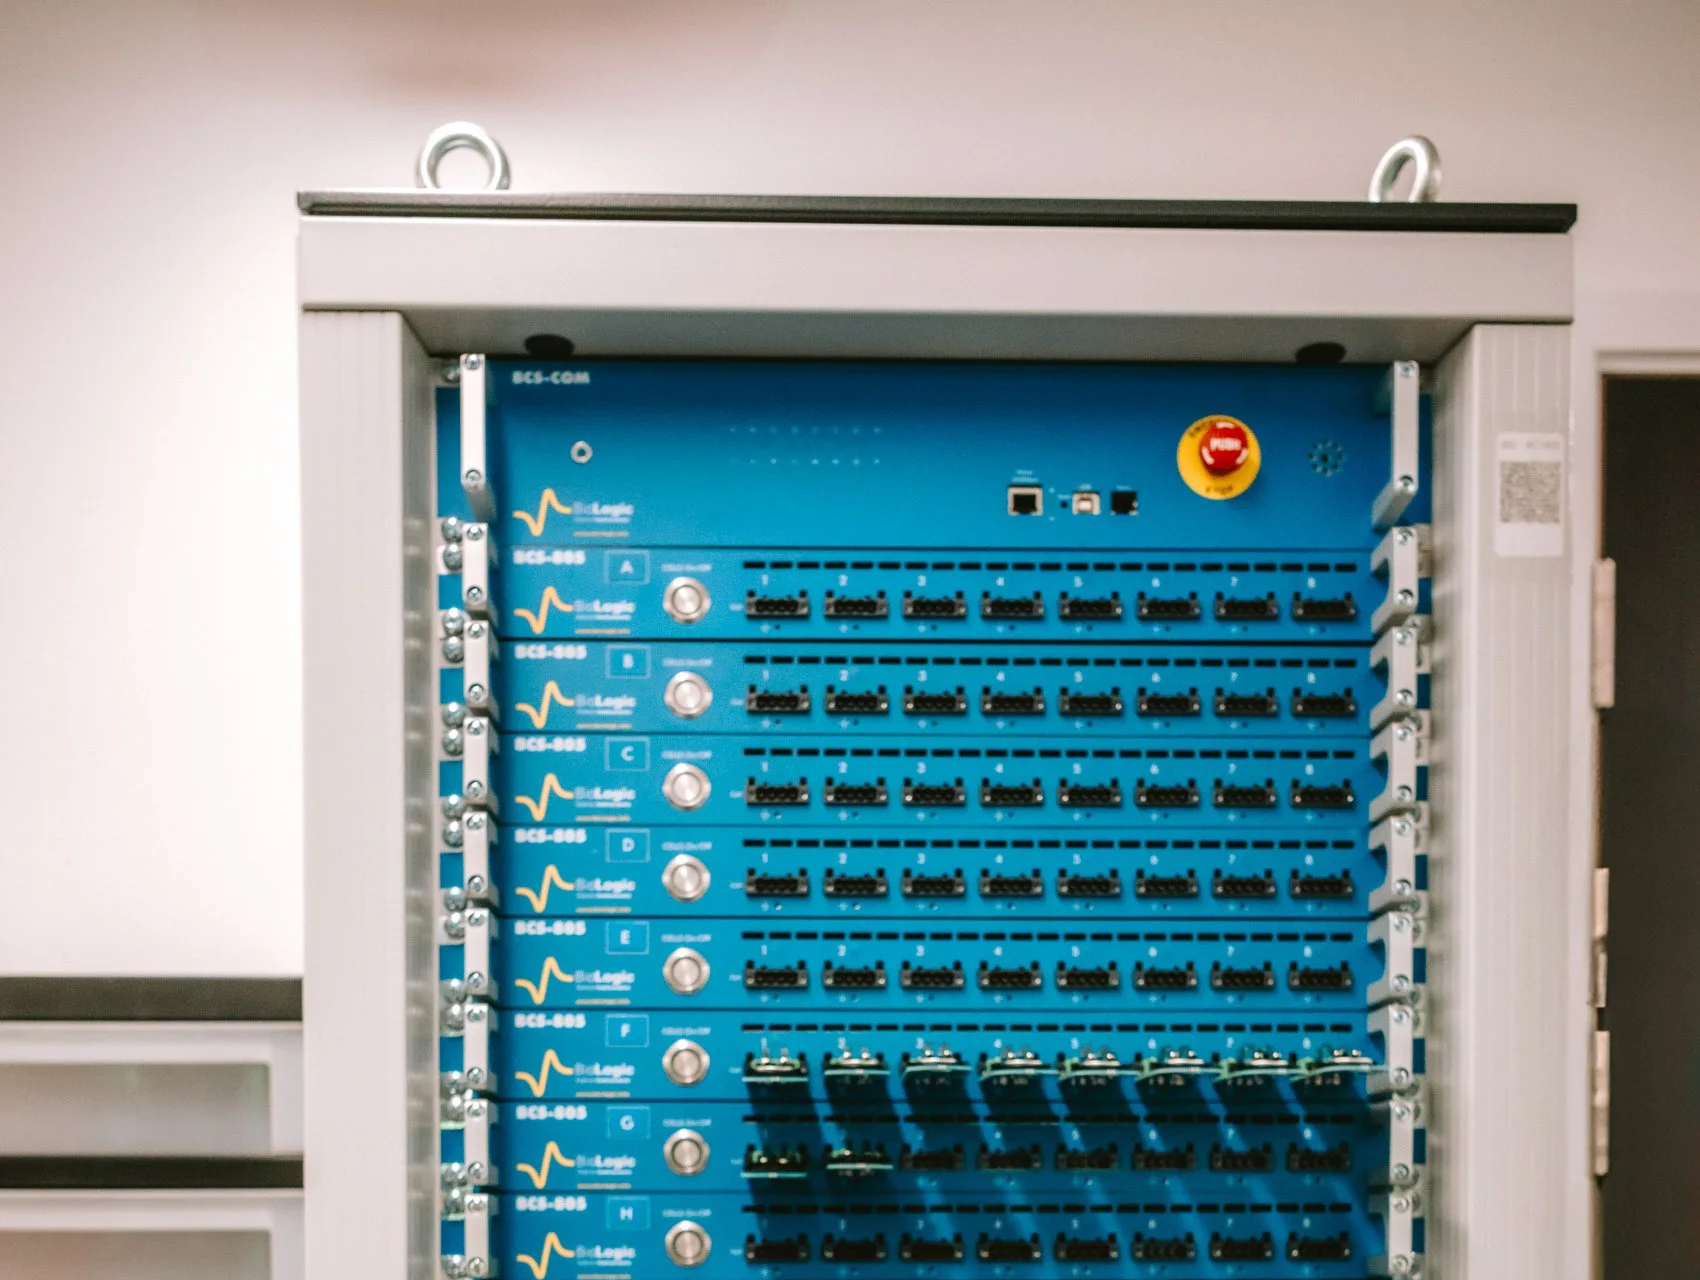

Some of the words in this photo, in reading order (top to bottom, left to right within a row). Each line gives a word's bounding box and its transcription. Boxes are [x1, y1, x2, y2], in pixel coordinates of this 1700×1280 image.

[512, 370, 590, 385] BCS-COM
[1210, 438, 1241, 451] PUSH
[619, 559, 634, 574] A
[622, 653, 634, 669] B
[620, 745, 634, 762] C
[621, 837, 636, 853] D
[619, 929, 631, 945] E
[620, 1023, 631, 1038] F
[619, 1114, 635, 1131] G
[619, 1206, 634, 1221] H
